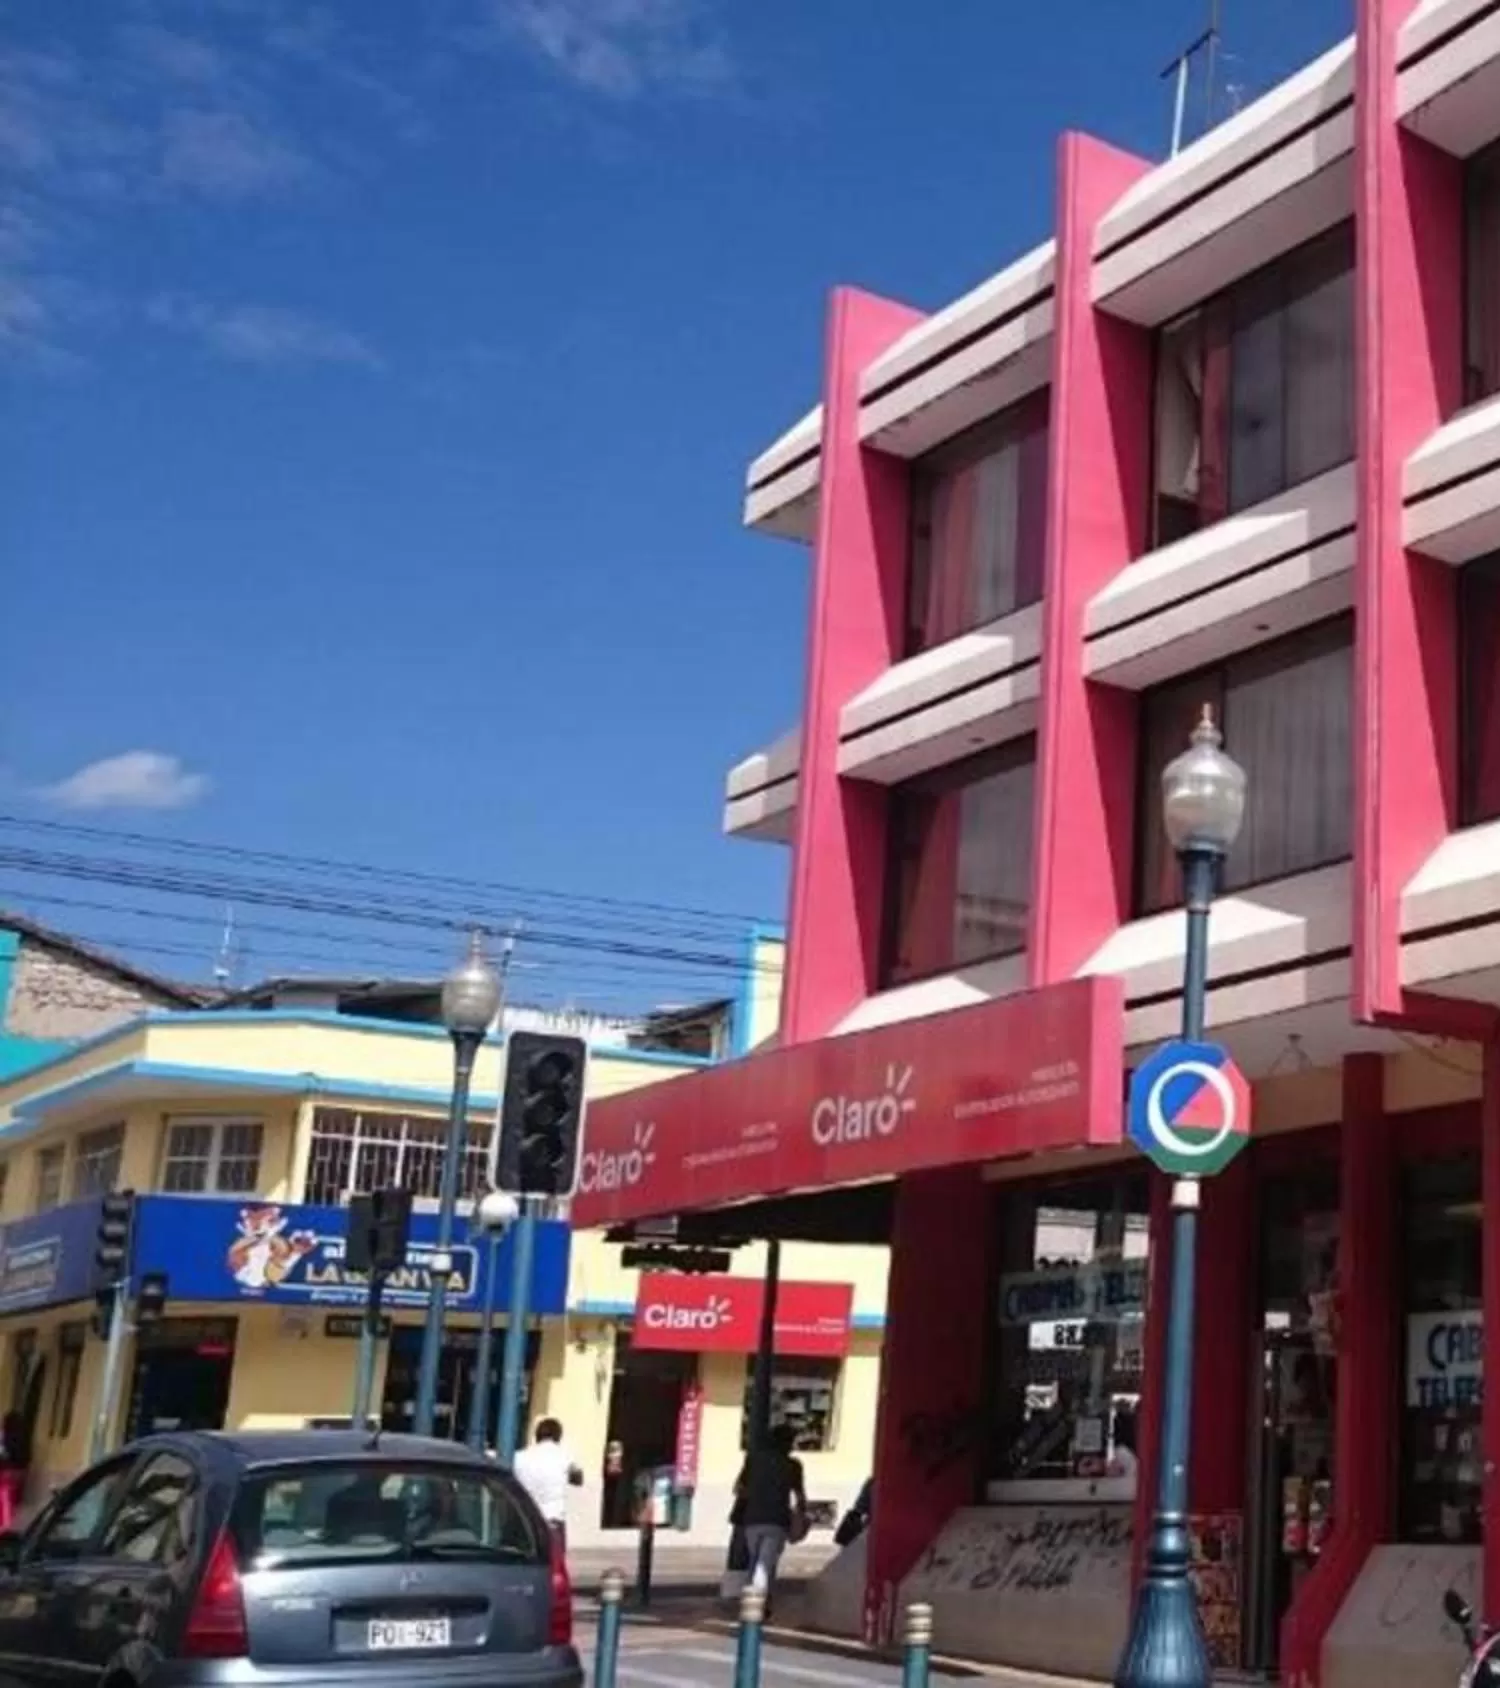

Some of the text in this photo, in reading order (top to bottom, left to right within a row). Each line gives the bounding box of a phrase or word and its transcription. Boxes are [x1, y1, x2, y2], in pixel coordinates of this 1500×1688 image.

[812, 1086, 901, 1146] Claro
[578, 1141, 645, 1192] Claro
[644, 1300, 720, 1329] Claro
